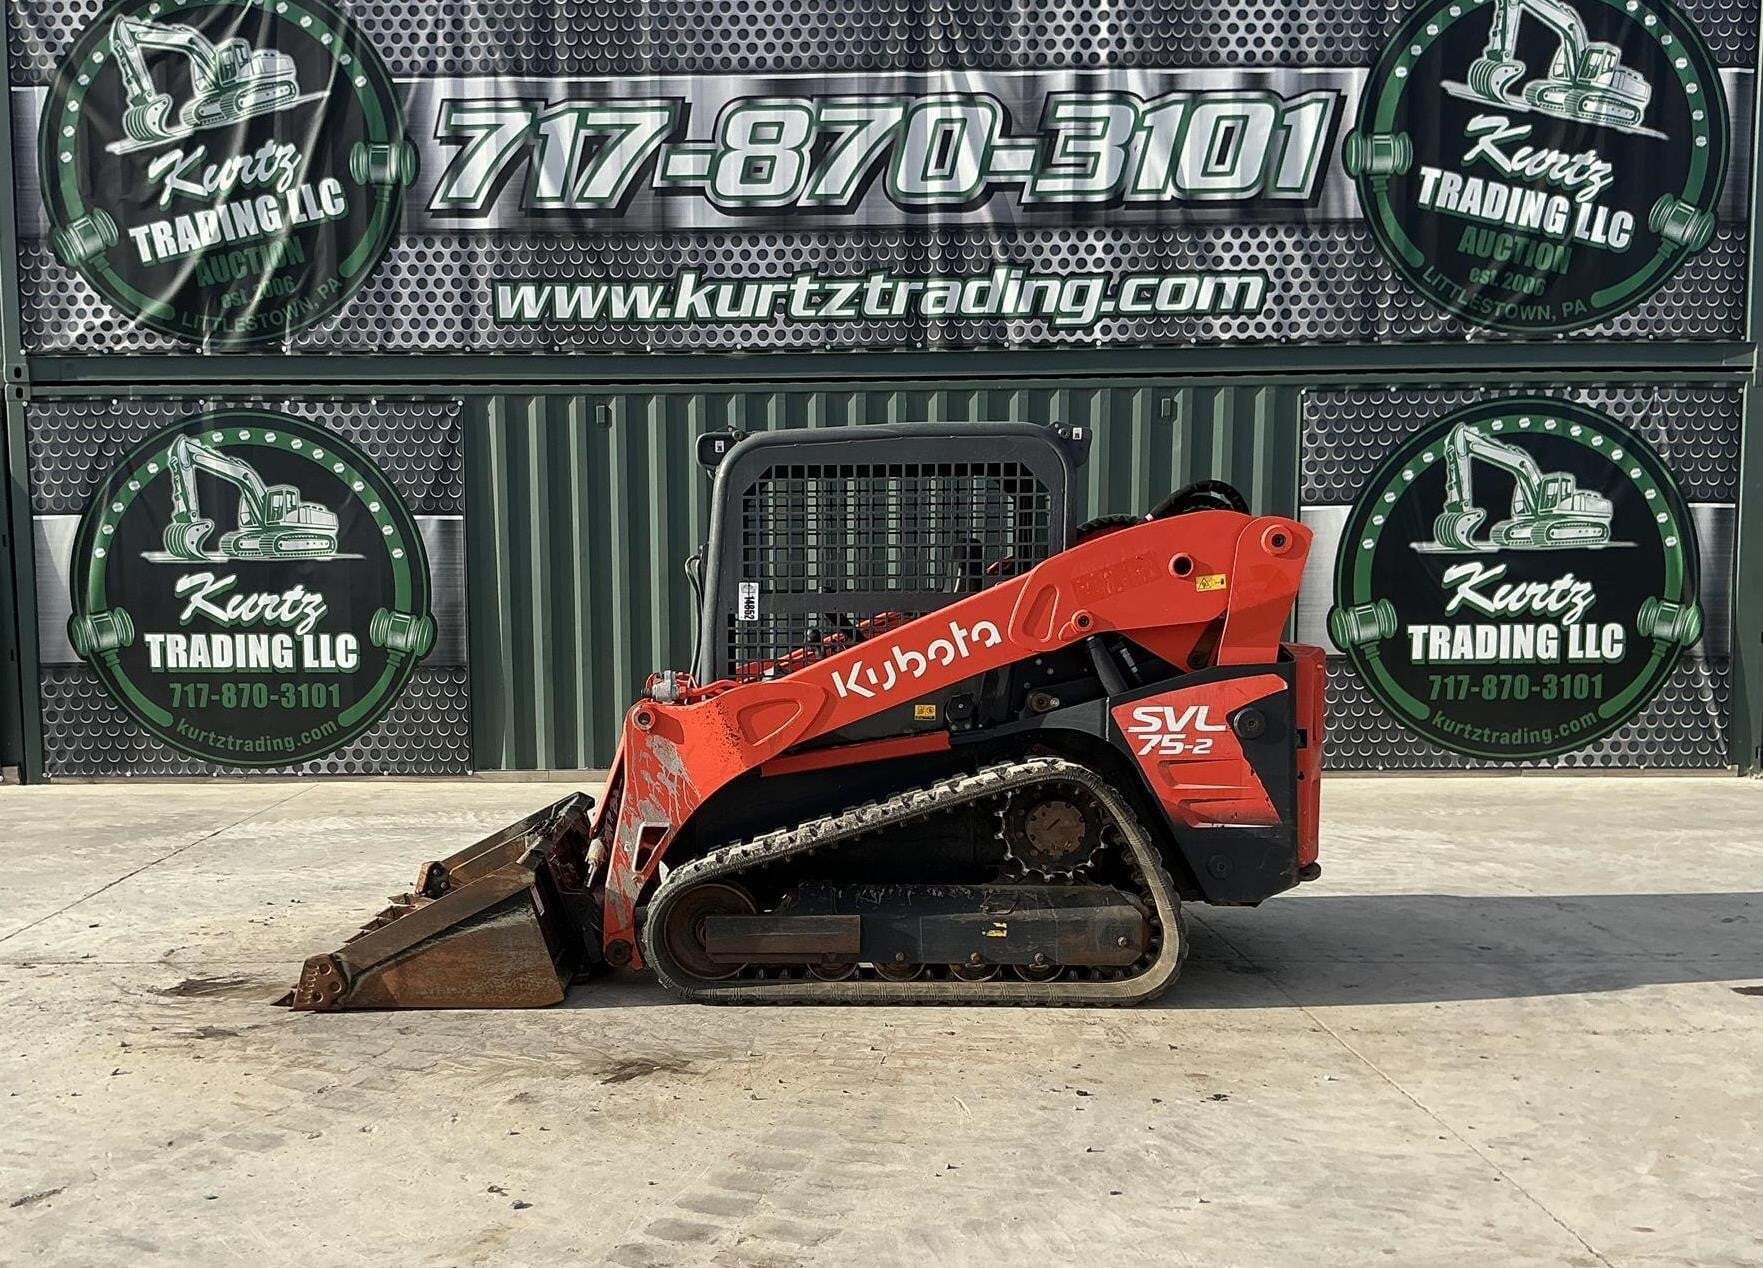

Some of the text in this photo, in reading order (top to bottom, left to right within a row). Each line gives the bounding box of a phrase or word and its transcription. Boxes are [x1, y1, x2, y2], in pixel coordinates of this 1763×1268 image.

[148, 139, 302, 206] Kurtz
[432, 92, 1339, 212] 717-870-3101
[1461, 114, 1614, 202] Kurtz
[129, 177, 346, 263] TRADING LLC
[1418, 166, 1634, 249] TRADING LLC
[195, 235, 305, 288] AUCTION
[1457, 225, 1573, 275] AUCTION
[316, 277, 343, 300] PA
[498, 267, 1265, 326] www.kurtztrading.com
[1422, 265, 1588, 323] LITTLESTOWN, PA
[1501, 271, 1546, 296] 2006
[175, 572, 327, 635] Kurtz
[743, 595, 756, 620] 14852
[1442, 561, 1597, 626] Kurtz
[144, 633, 358, 669] TRADING LLC
[831, 620, 1003, 698] Kubota
[1407, 623, 1626, 661] TRADING LLC
[169, 682, 341, 708] 717-870-3101
[1427, 673, 1603, 700] 717-870-3101
[176, 718, 338, 753] kurtztrading.com
[1127, 705, 1226, 732] SVL
[1431, 710, 1598, 746] kurtztrading.com
[1137, 733, 1213, 756] 75-2
